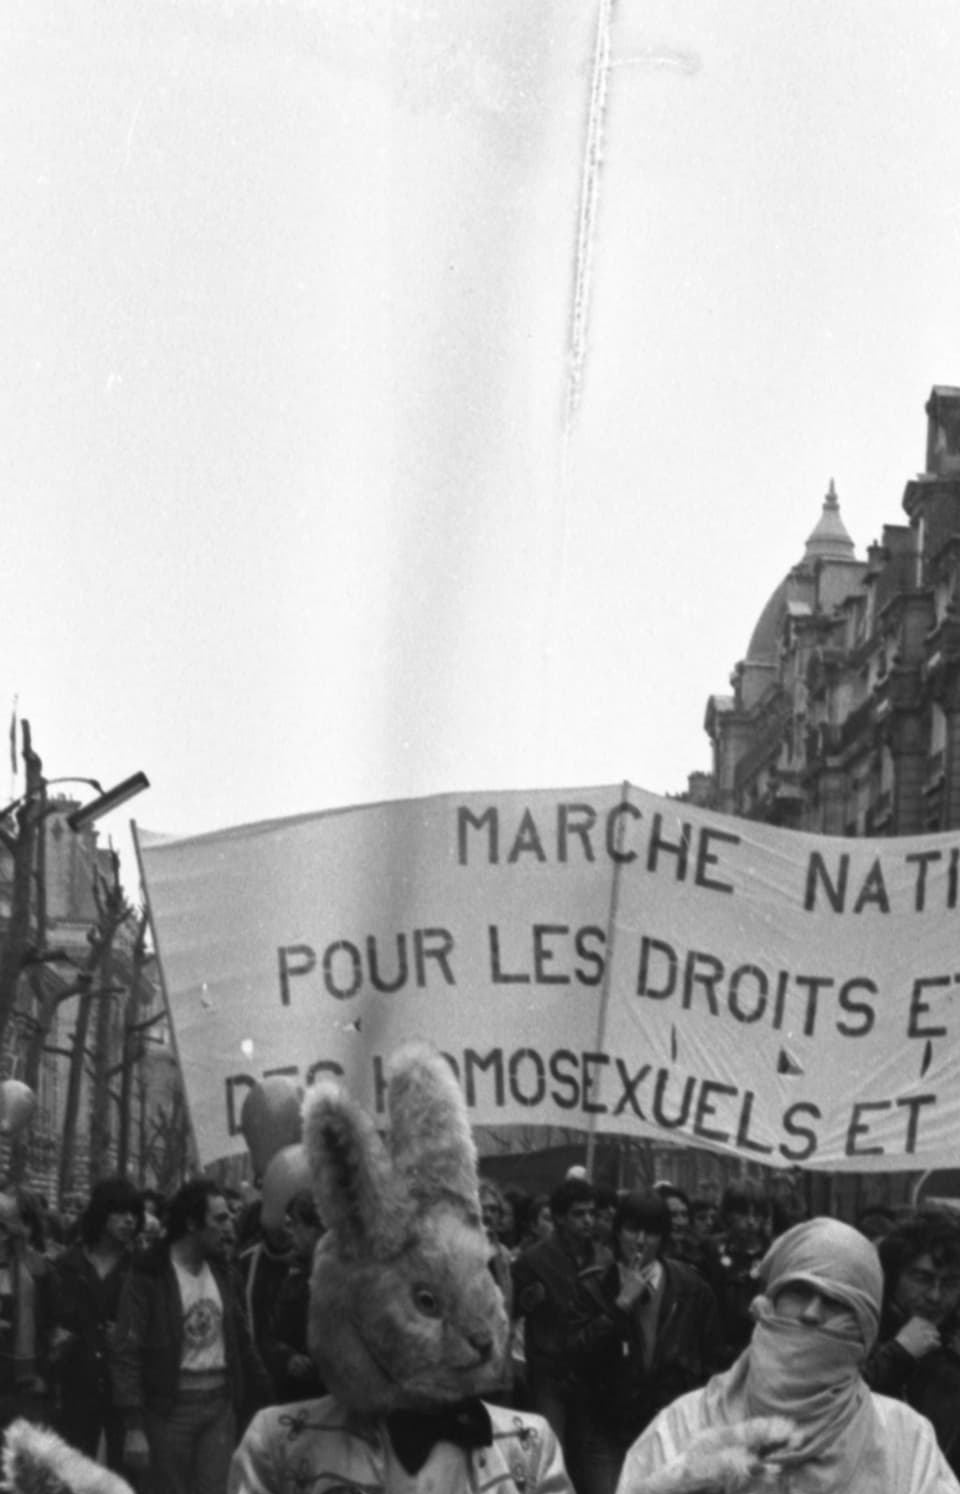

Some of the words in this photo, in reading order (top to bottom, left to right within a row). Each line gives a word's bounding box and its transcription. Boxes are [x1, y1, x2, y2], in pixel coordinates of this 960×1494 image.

[455, 803, 741, 894] MARCHE
[277, 928, 455, 1006] POUR
[489, 924, 607, 987] LES
[636, 936, 878, 1037] DROITS
[373, 1047, 821, 1162] MOSEXUELS
[844, 1094, 936, 1156] ET
